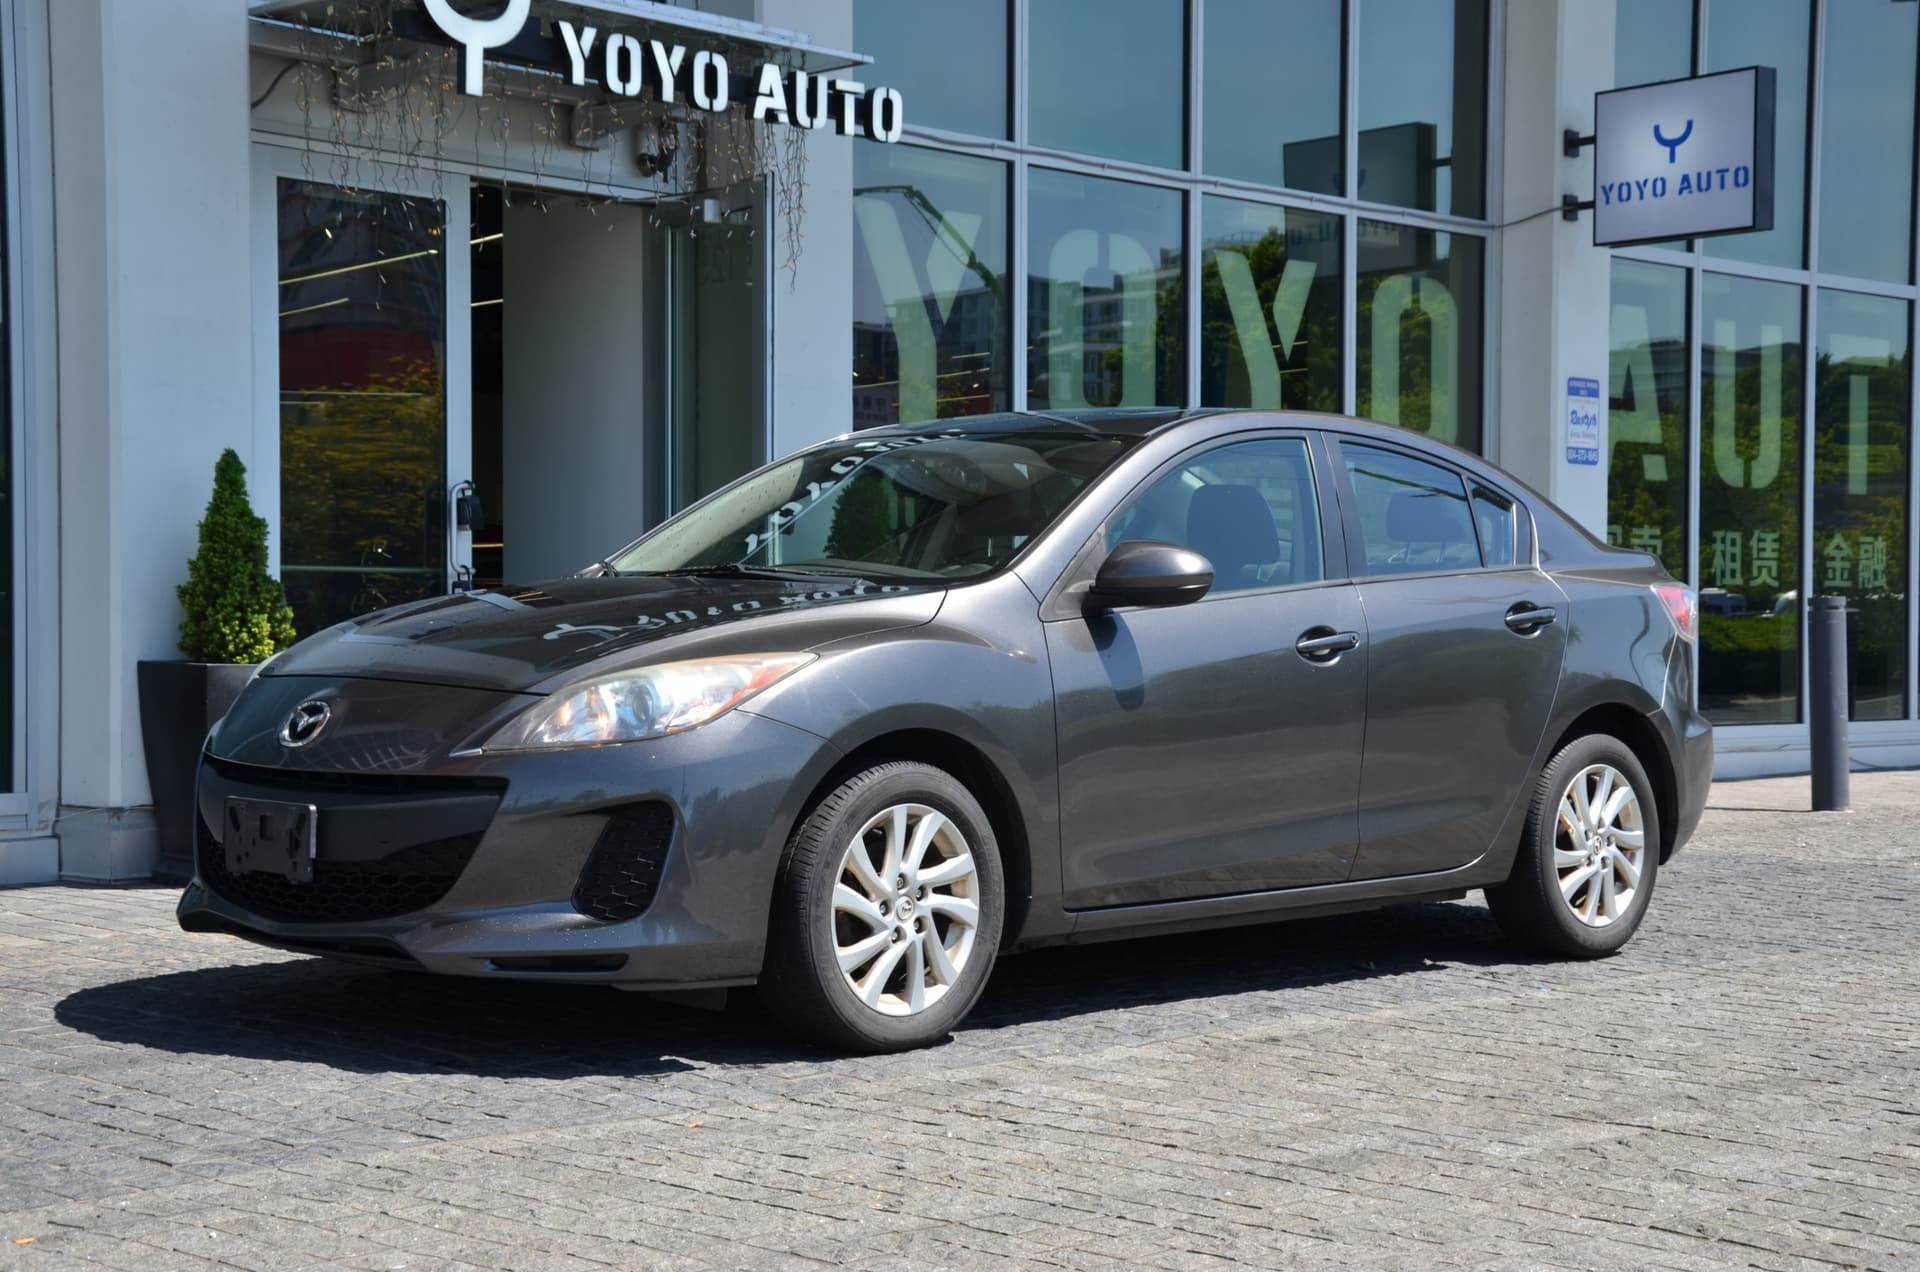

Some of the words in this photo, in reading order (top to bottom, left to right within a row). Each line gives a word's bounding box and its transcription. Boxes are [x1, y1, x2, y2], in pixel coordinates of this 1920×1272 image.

[557, 20, 730, 112] YOYO
[753, 62, 905, 144] AUTO
[1601, 176, 1667, 206] YOYO
[1678, 165, 1750, 196] AUTO
[1711, 529, 1780, 588] 租赁
[1823, 532, 1888, 590] 金融
